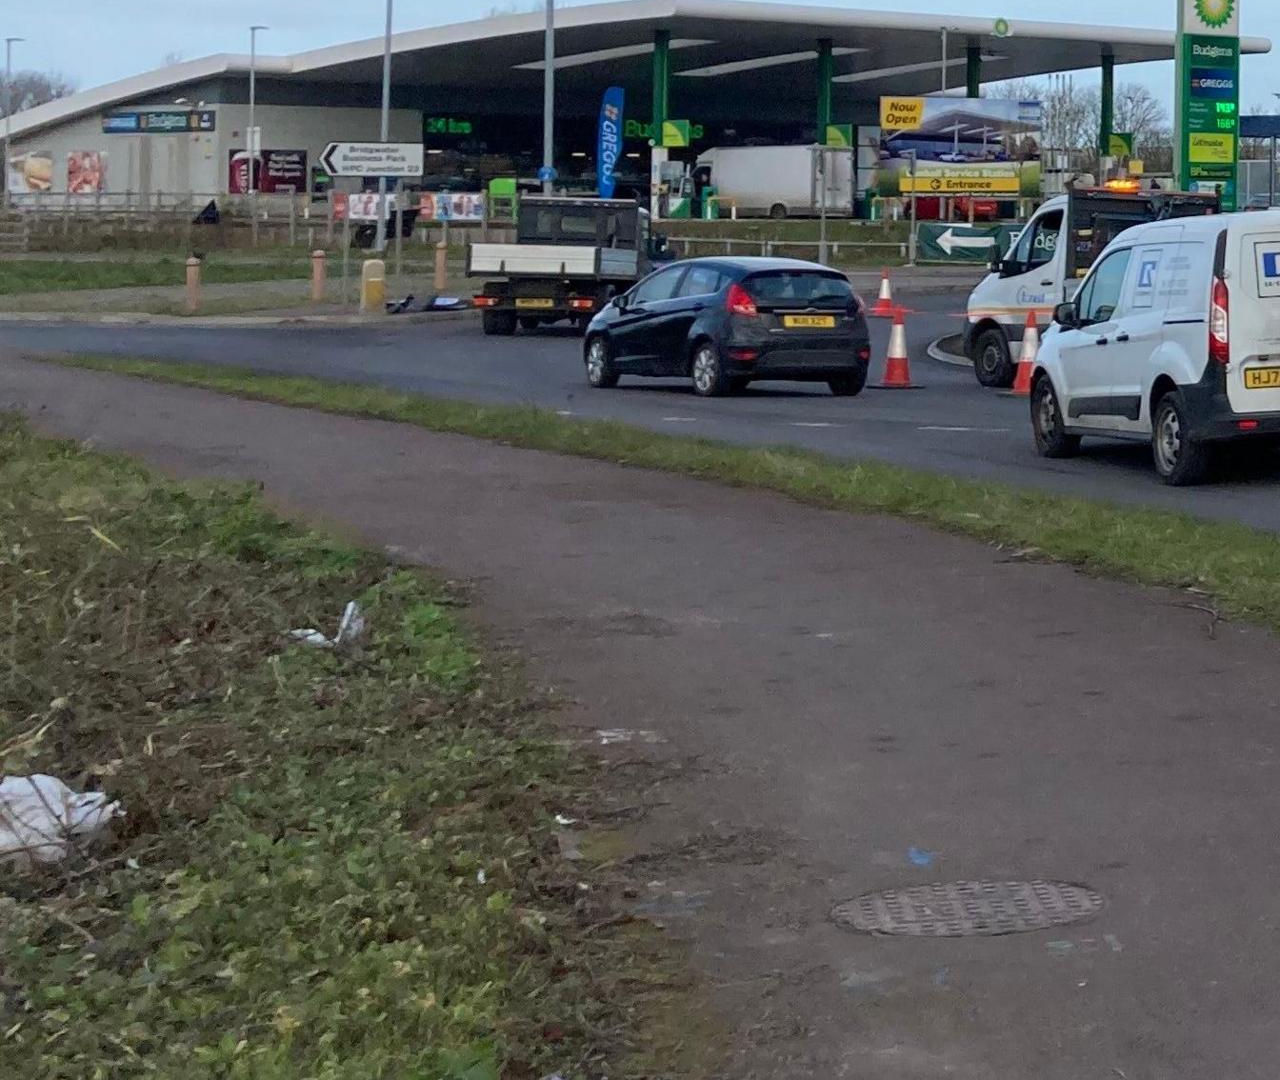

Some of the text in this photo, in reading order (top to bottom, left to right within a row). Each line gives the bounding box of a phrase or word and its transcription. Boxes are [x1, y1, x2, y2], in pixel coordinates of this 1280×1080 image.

[1192, 44, 1233, 58] Budgens
[1200, 78, 1234, 88] GREGGS
[889, 101, 916, 112] Now
[885, 113, 917, 125] Open
[946, 179, 993, 189] Entrance
